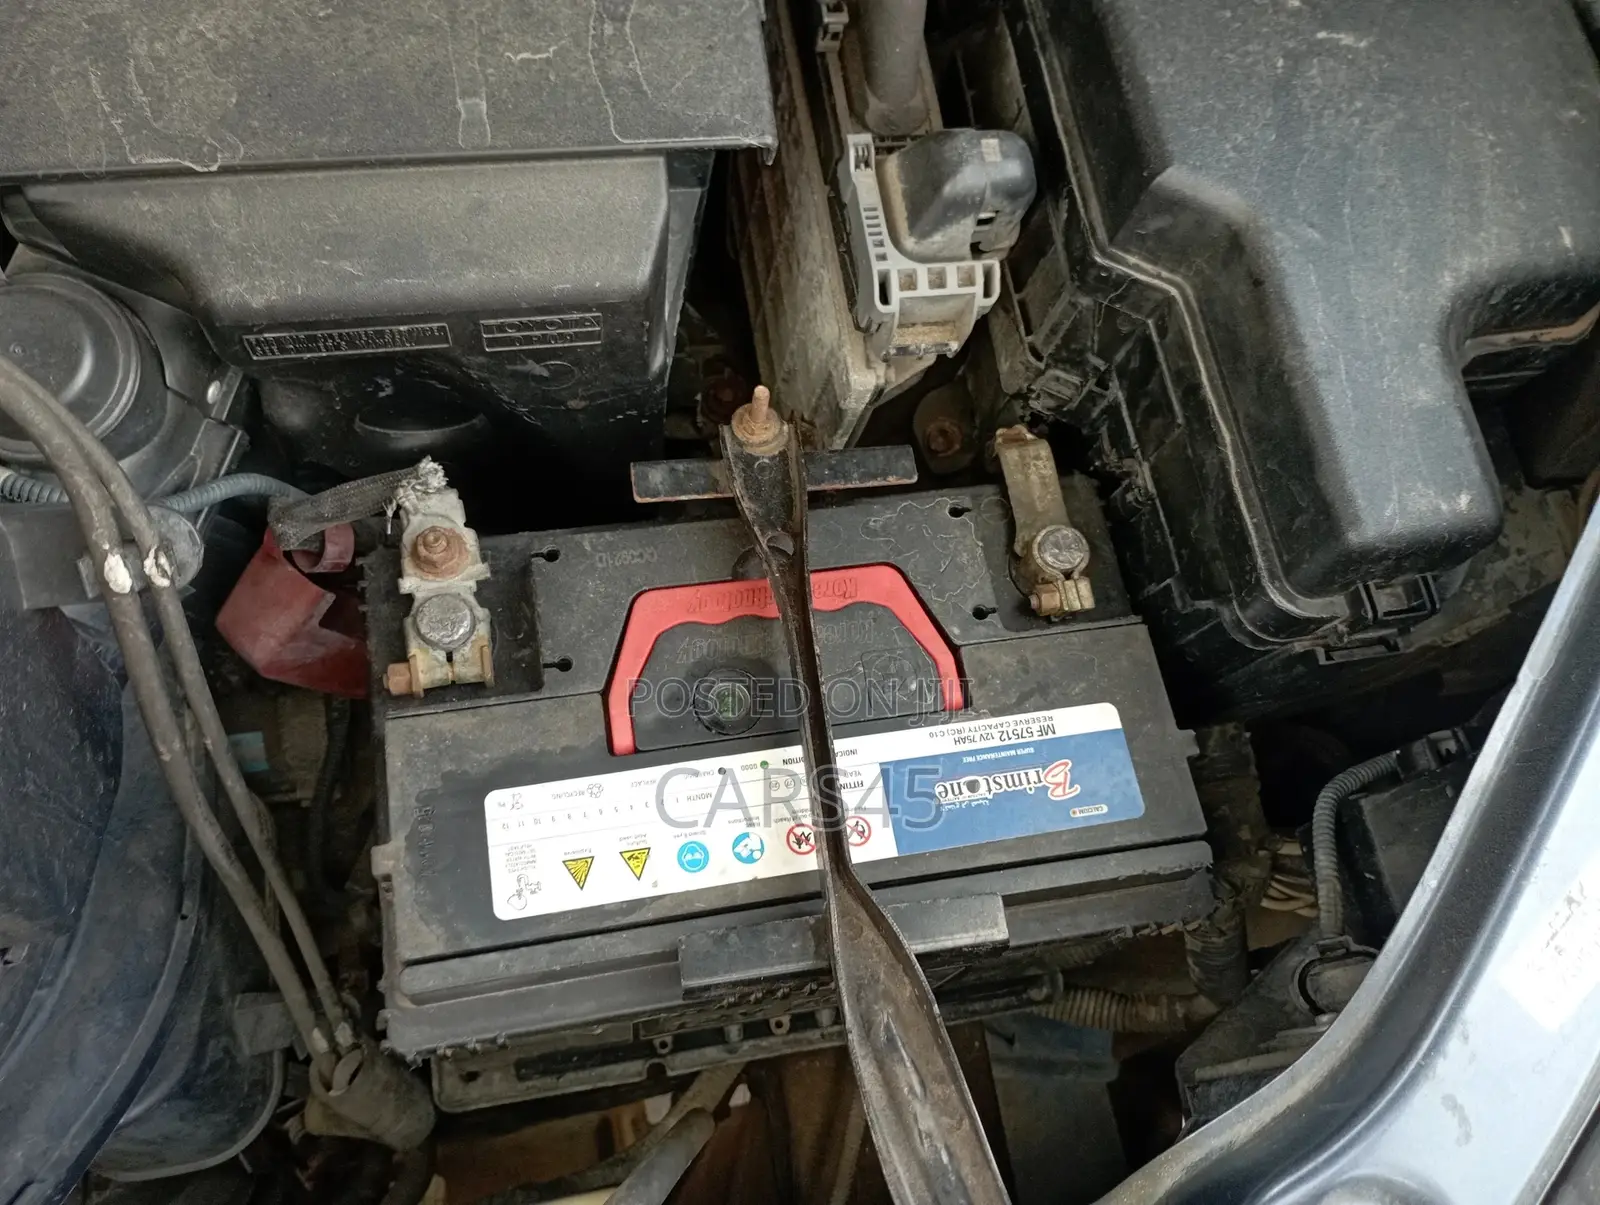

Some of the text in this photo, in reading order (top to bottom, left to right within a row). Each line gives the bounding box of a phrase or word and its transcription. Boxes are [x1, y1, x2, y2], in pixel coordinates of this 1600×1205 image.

[685, 577, 858, 616] Kore chnology
[928, 714, 1052, 738] RESERVE CAPACITY (RC) C10
[953, 722, 1055, 745] MF 57512 12V 75AH
[782, 748, 857, 765] INDICA DITION
[961, 746, 1034, 763] SUPER MAINTENANCE FREE
[839, 780, 863, 790] FITTIN
[686, 791, 712, 801] MONTH
